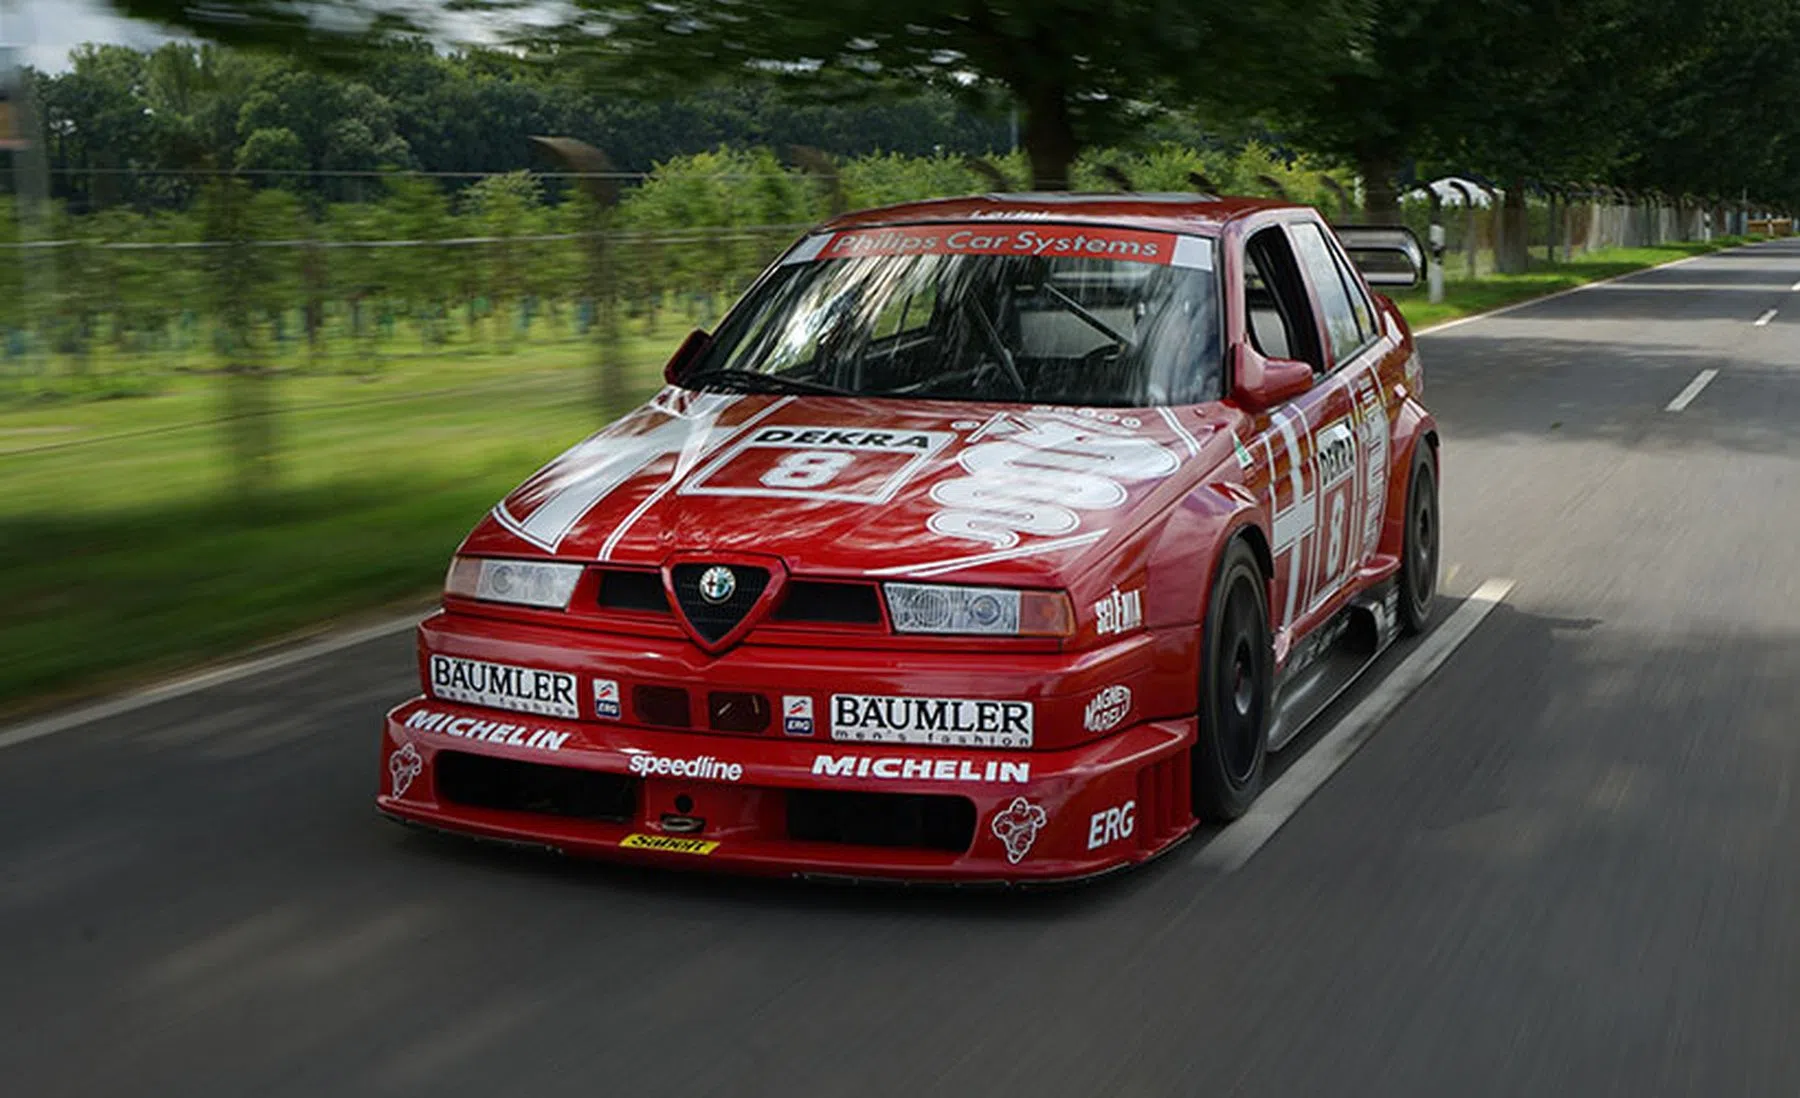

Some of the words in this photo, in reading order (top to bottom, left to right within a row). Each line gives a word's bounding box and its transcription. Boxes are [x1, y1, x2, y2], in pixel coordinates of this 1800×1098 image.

[831, 232, 937, 254] Philips
[946, 230, 1008, 250] Car
[1014, 230, 1158, 257] Systems
[754, 428, 930, 450] DEKRA
[758, 450, 857, 488] 8
[1326, 490, 1345, 581] 8
[434, 657, 575, 706] BÄUMLER
[404, 709, 570, 750] MICHELIN
[835, 697, 1029, 733] BÄUMLER
[835, 730, 906, 741] men's
[927, 732, 1030, 746] fashion
[629, 753, 743, 781] speedline
[812, 755, 1030, 783] MICHELIN
[1087, 801, 1136, 850] ERG
